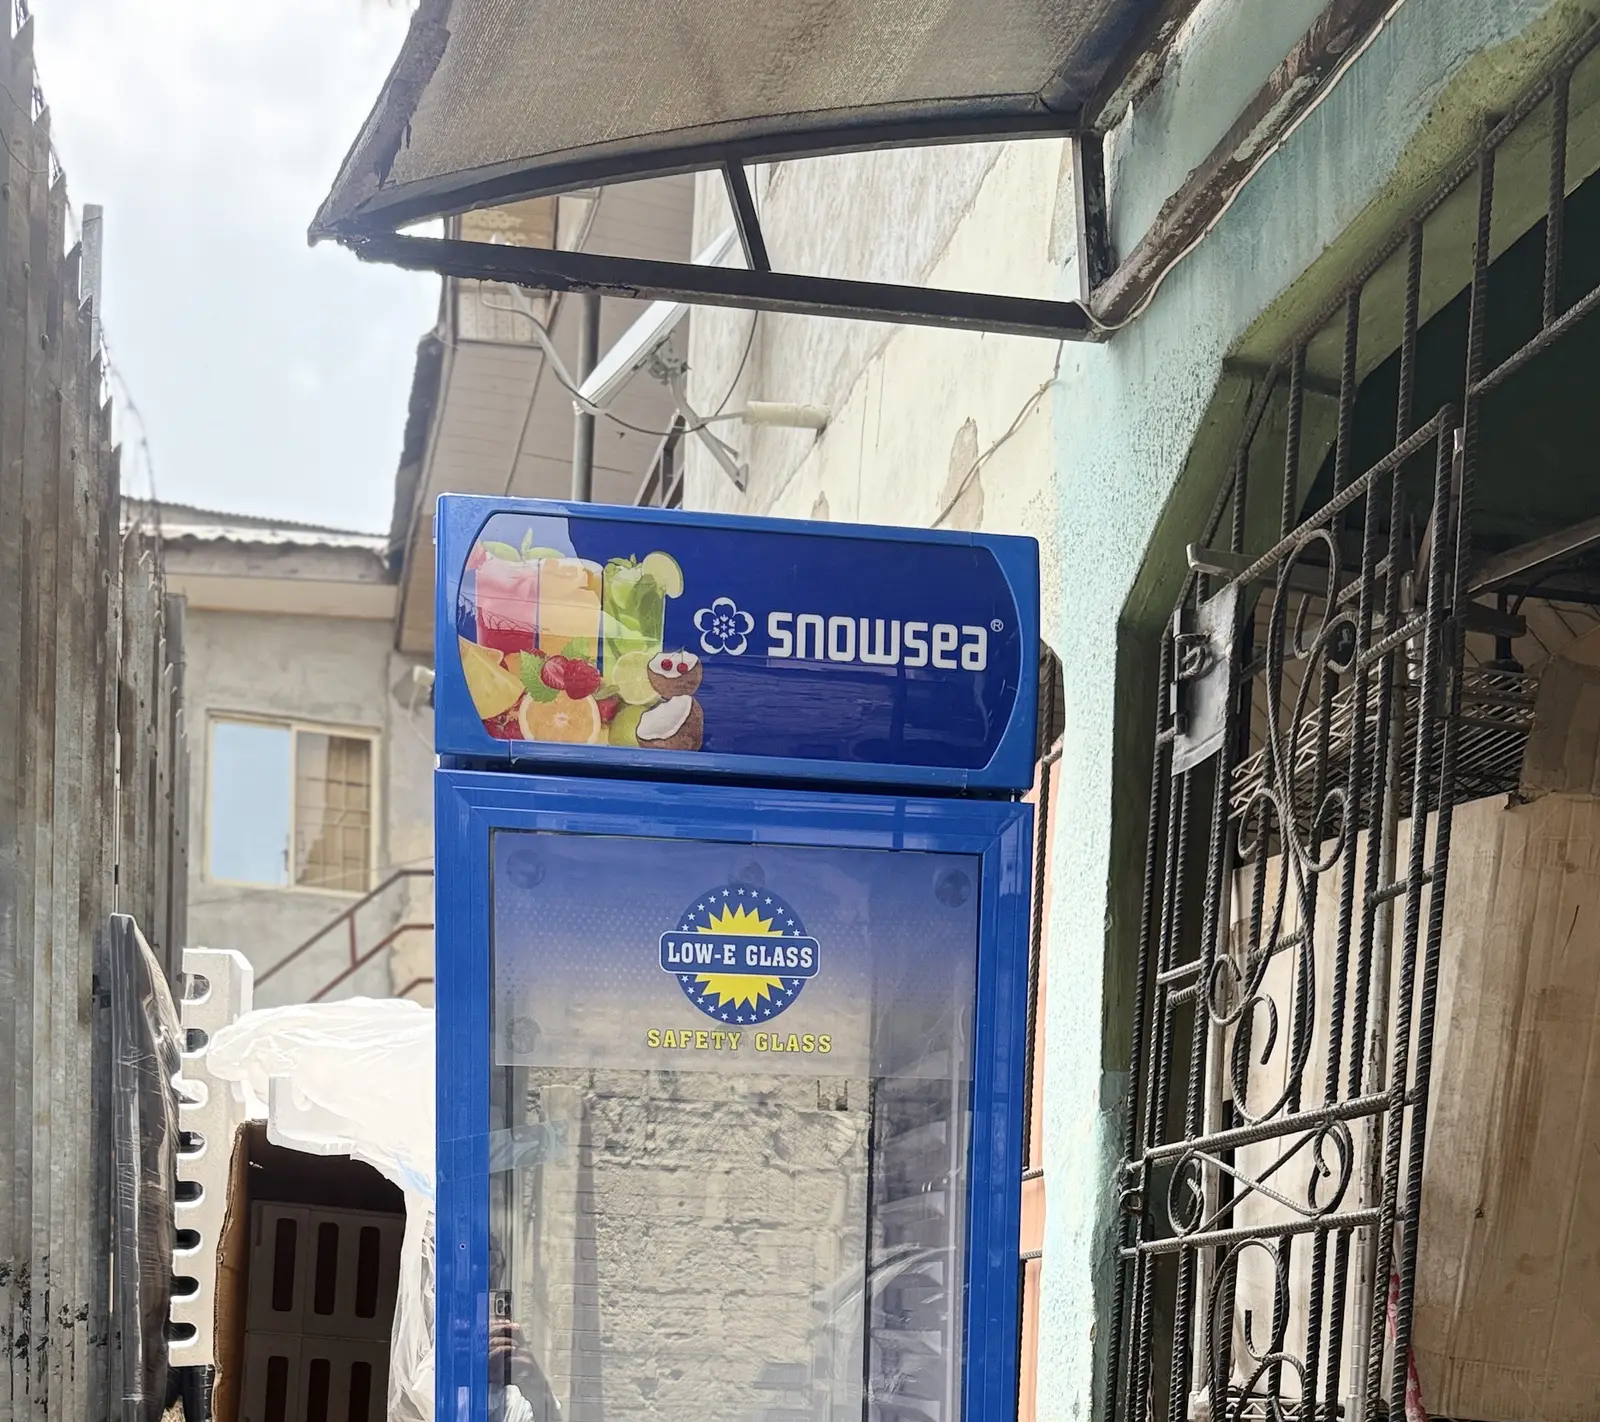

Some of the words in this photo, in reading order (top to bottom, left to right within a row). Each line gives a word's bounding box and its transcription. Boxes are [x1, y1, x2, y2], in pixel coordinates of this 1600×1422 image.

[667, 941, 737, 966] LOW-E
[745, 945, 813, 969] GLASS
[647, 1029, 741, 1050] SAFETY
[755, 1032, 832, 1053] GLASS
